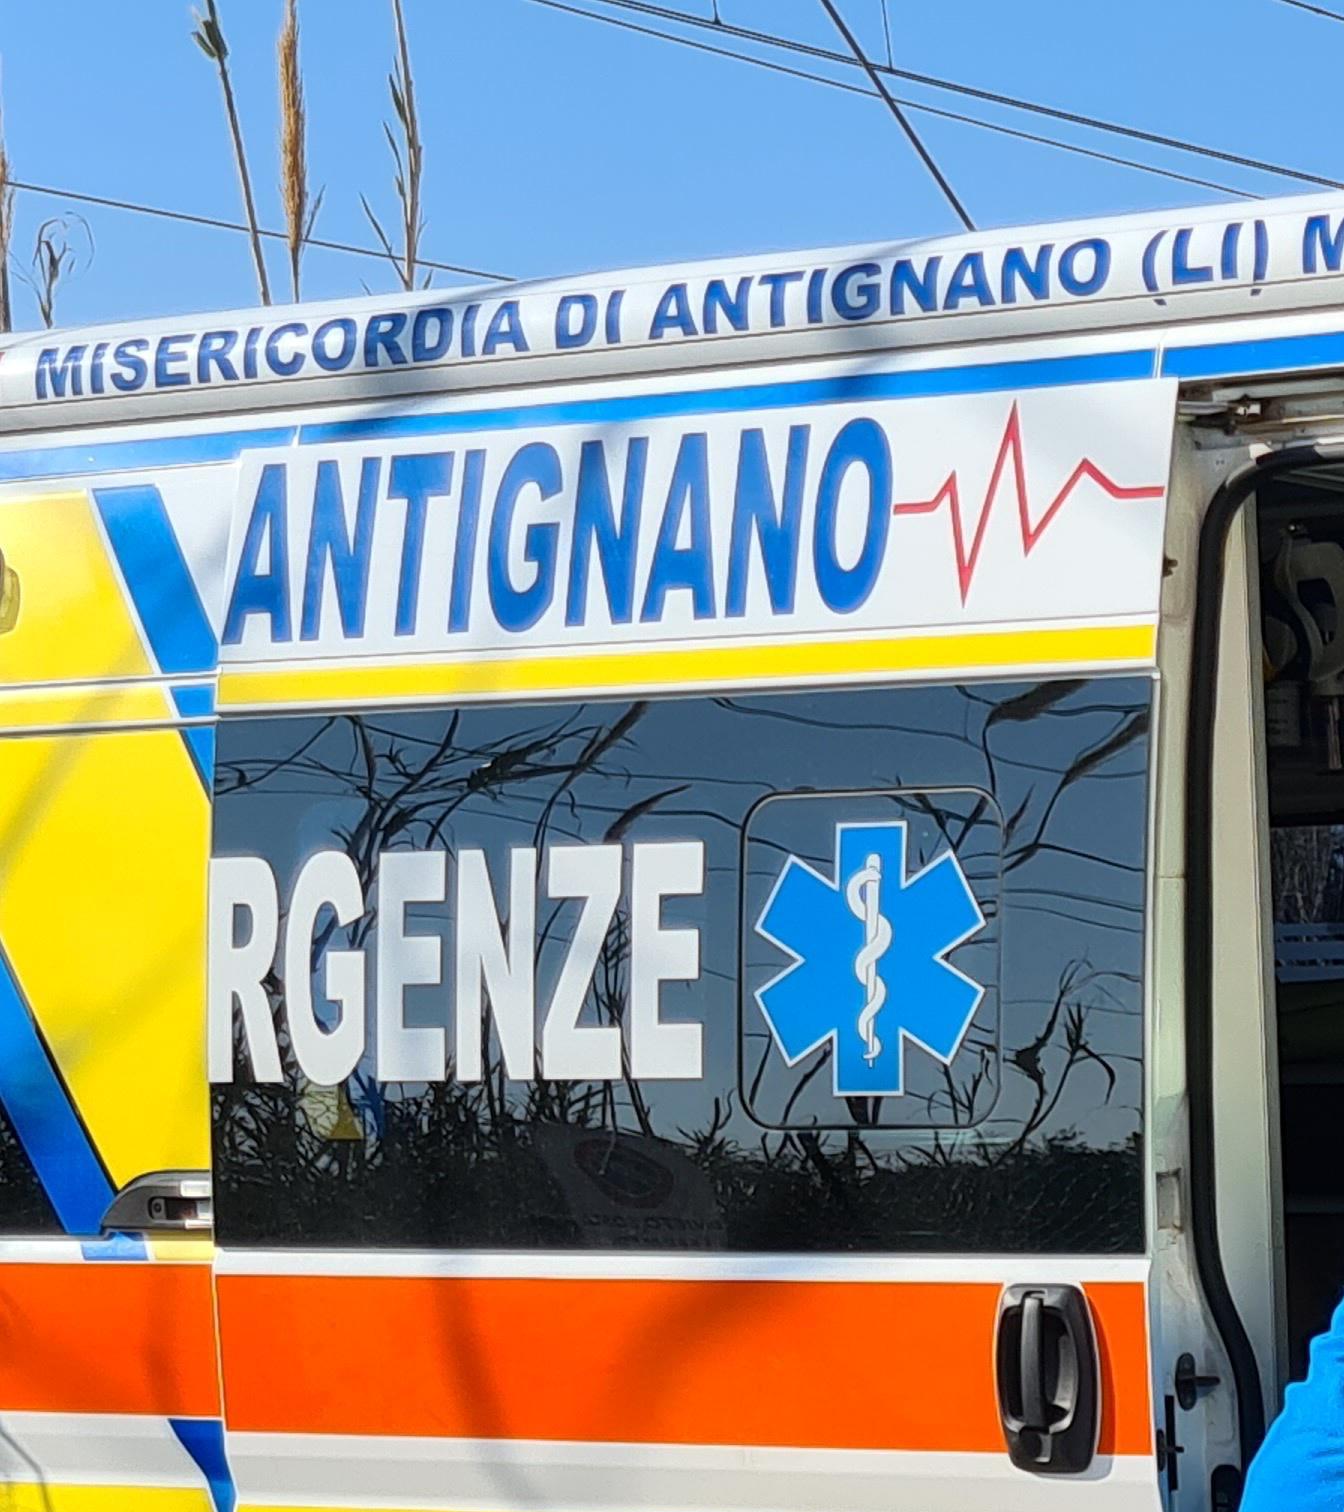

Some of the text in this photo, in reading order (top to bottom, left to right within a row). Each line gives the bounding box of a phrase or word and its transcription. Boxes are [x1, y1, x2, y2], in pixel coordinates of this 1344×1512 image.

[36, 301, 529, 400] MISERICORDIA
[555, 289, 625, 350] DI
[649, 238, 1111, 341] ANTIGNANO
[1142, 219, 1268, 306] (LI)
[221, 417, 896, 645] ANTIGNANO
[209, 841, 706, 1087] RGENZE
